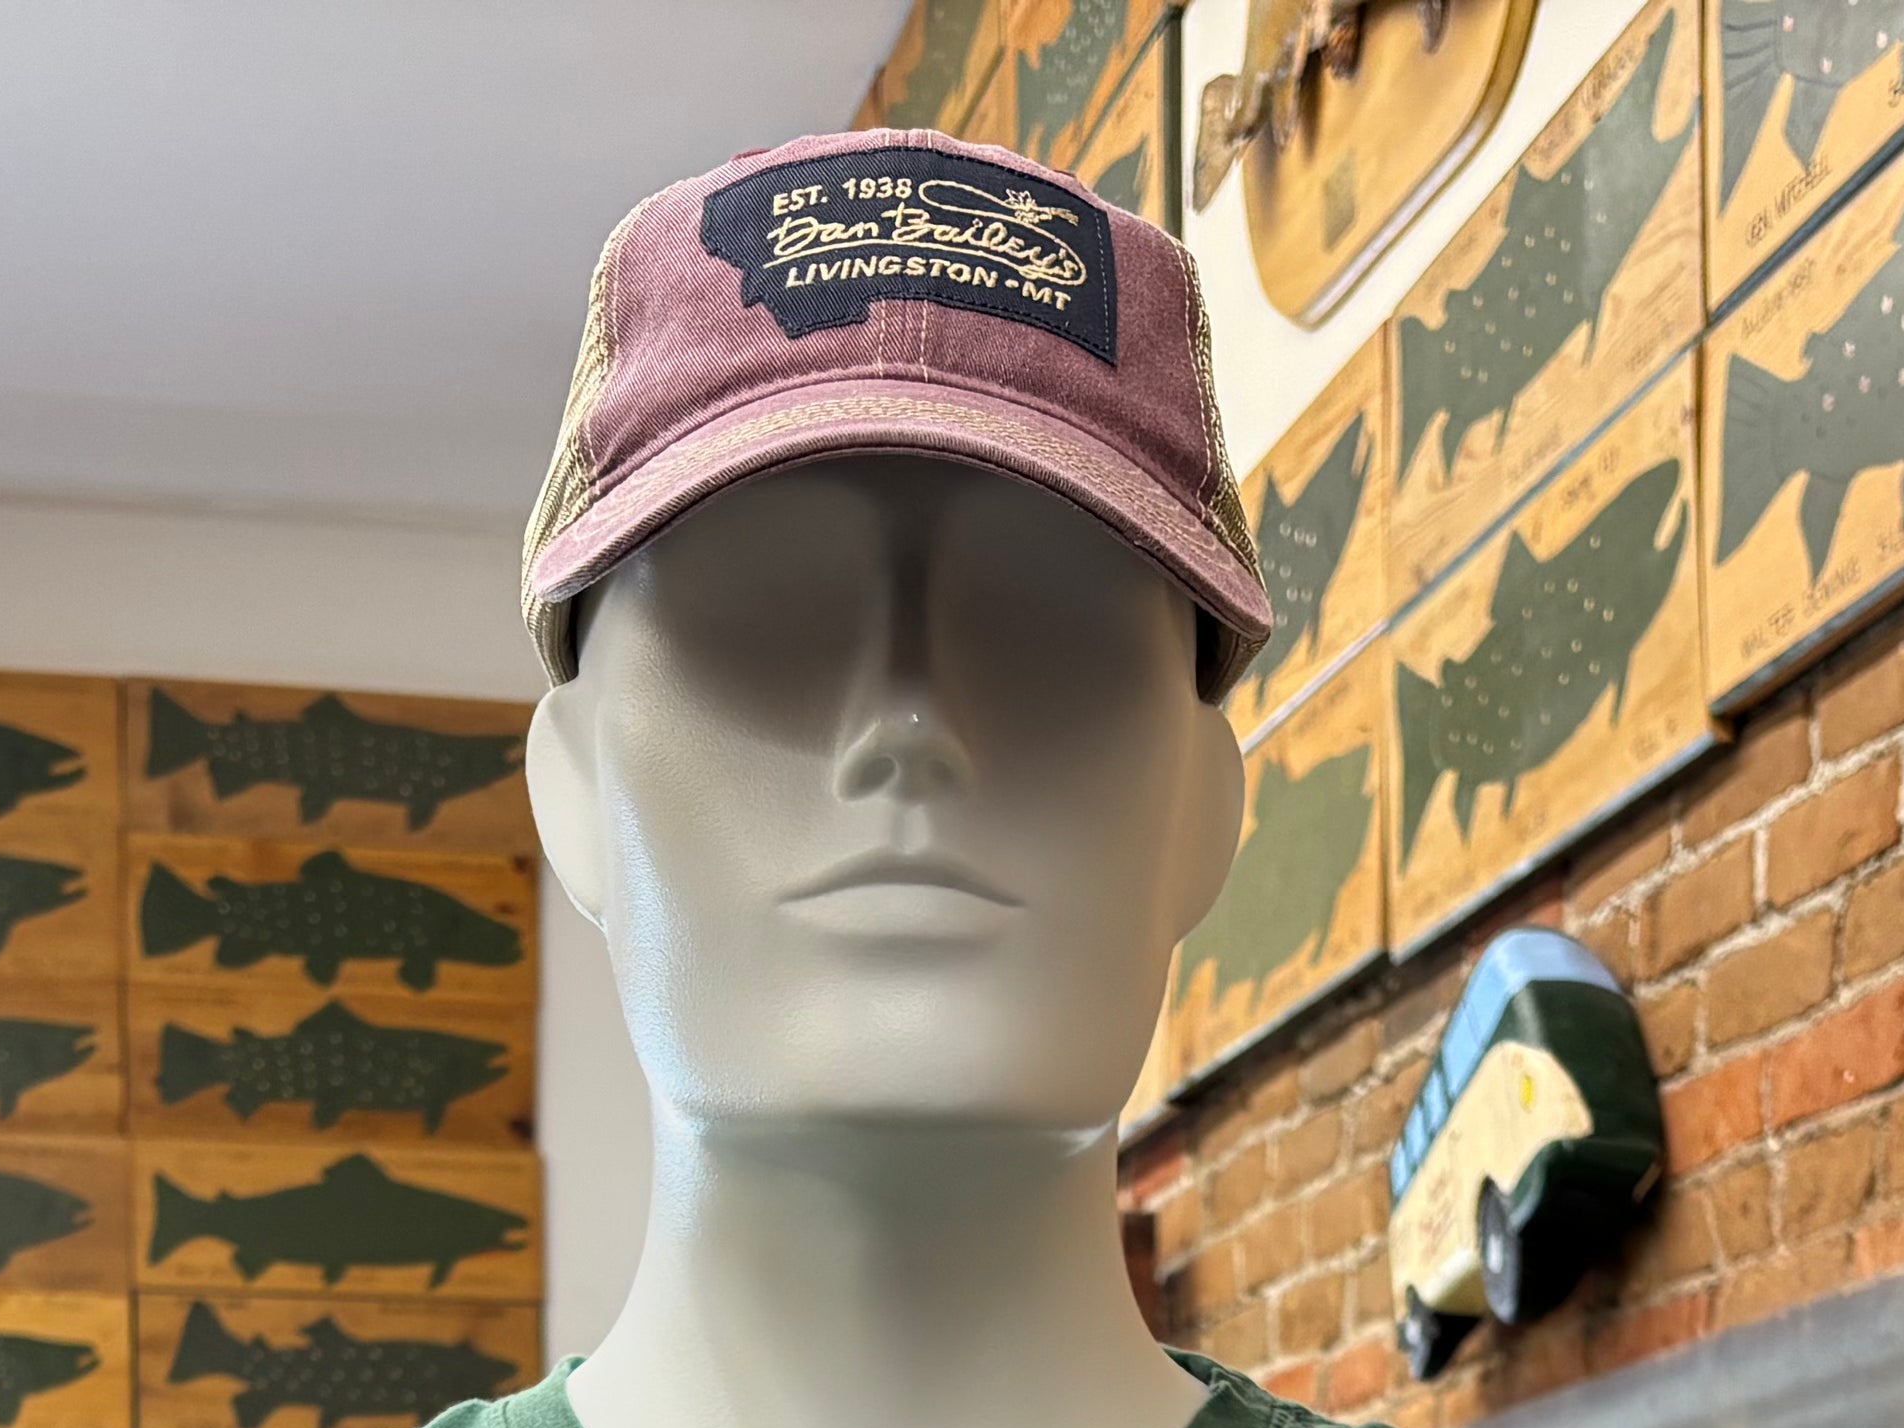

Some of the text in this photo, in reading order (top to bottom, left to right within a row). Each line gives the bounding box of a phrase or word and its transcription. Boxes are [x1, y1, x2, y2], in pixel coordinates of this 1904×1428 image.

[772, 176, 914, 217] EST. 1938
[767, 216, 880, 257] Dan
[784, 255, 1000, 288] LIVINGSTON
